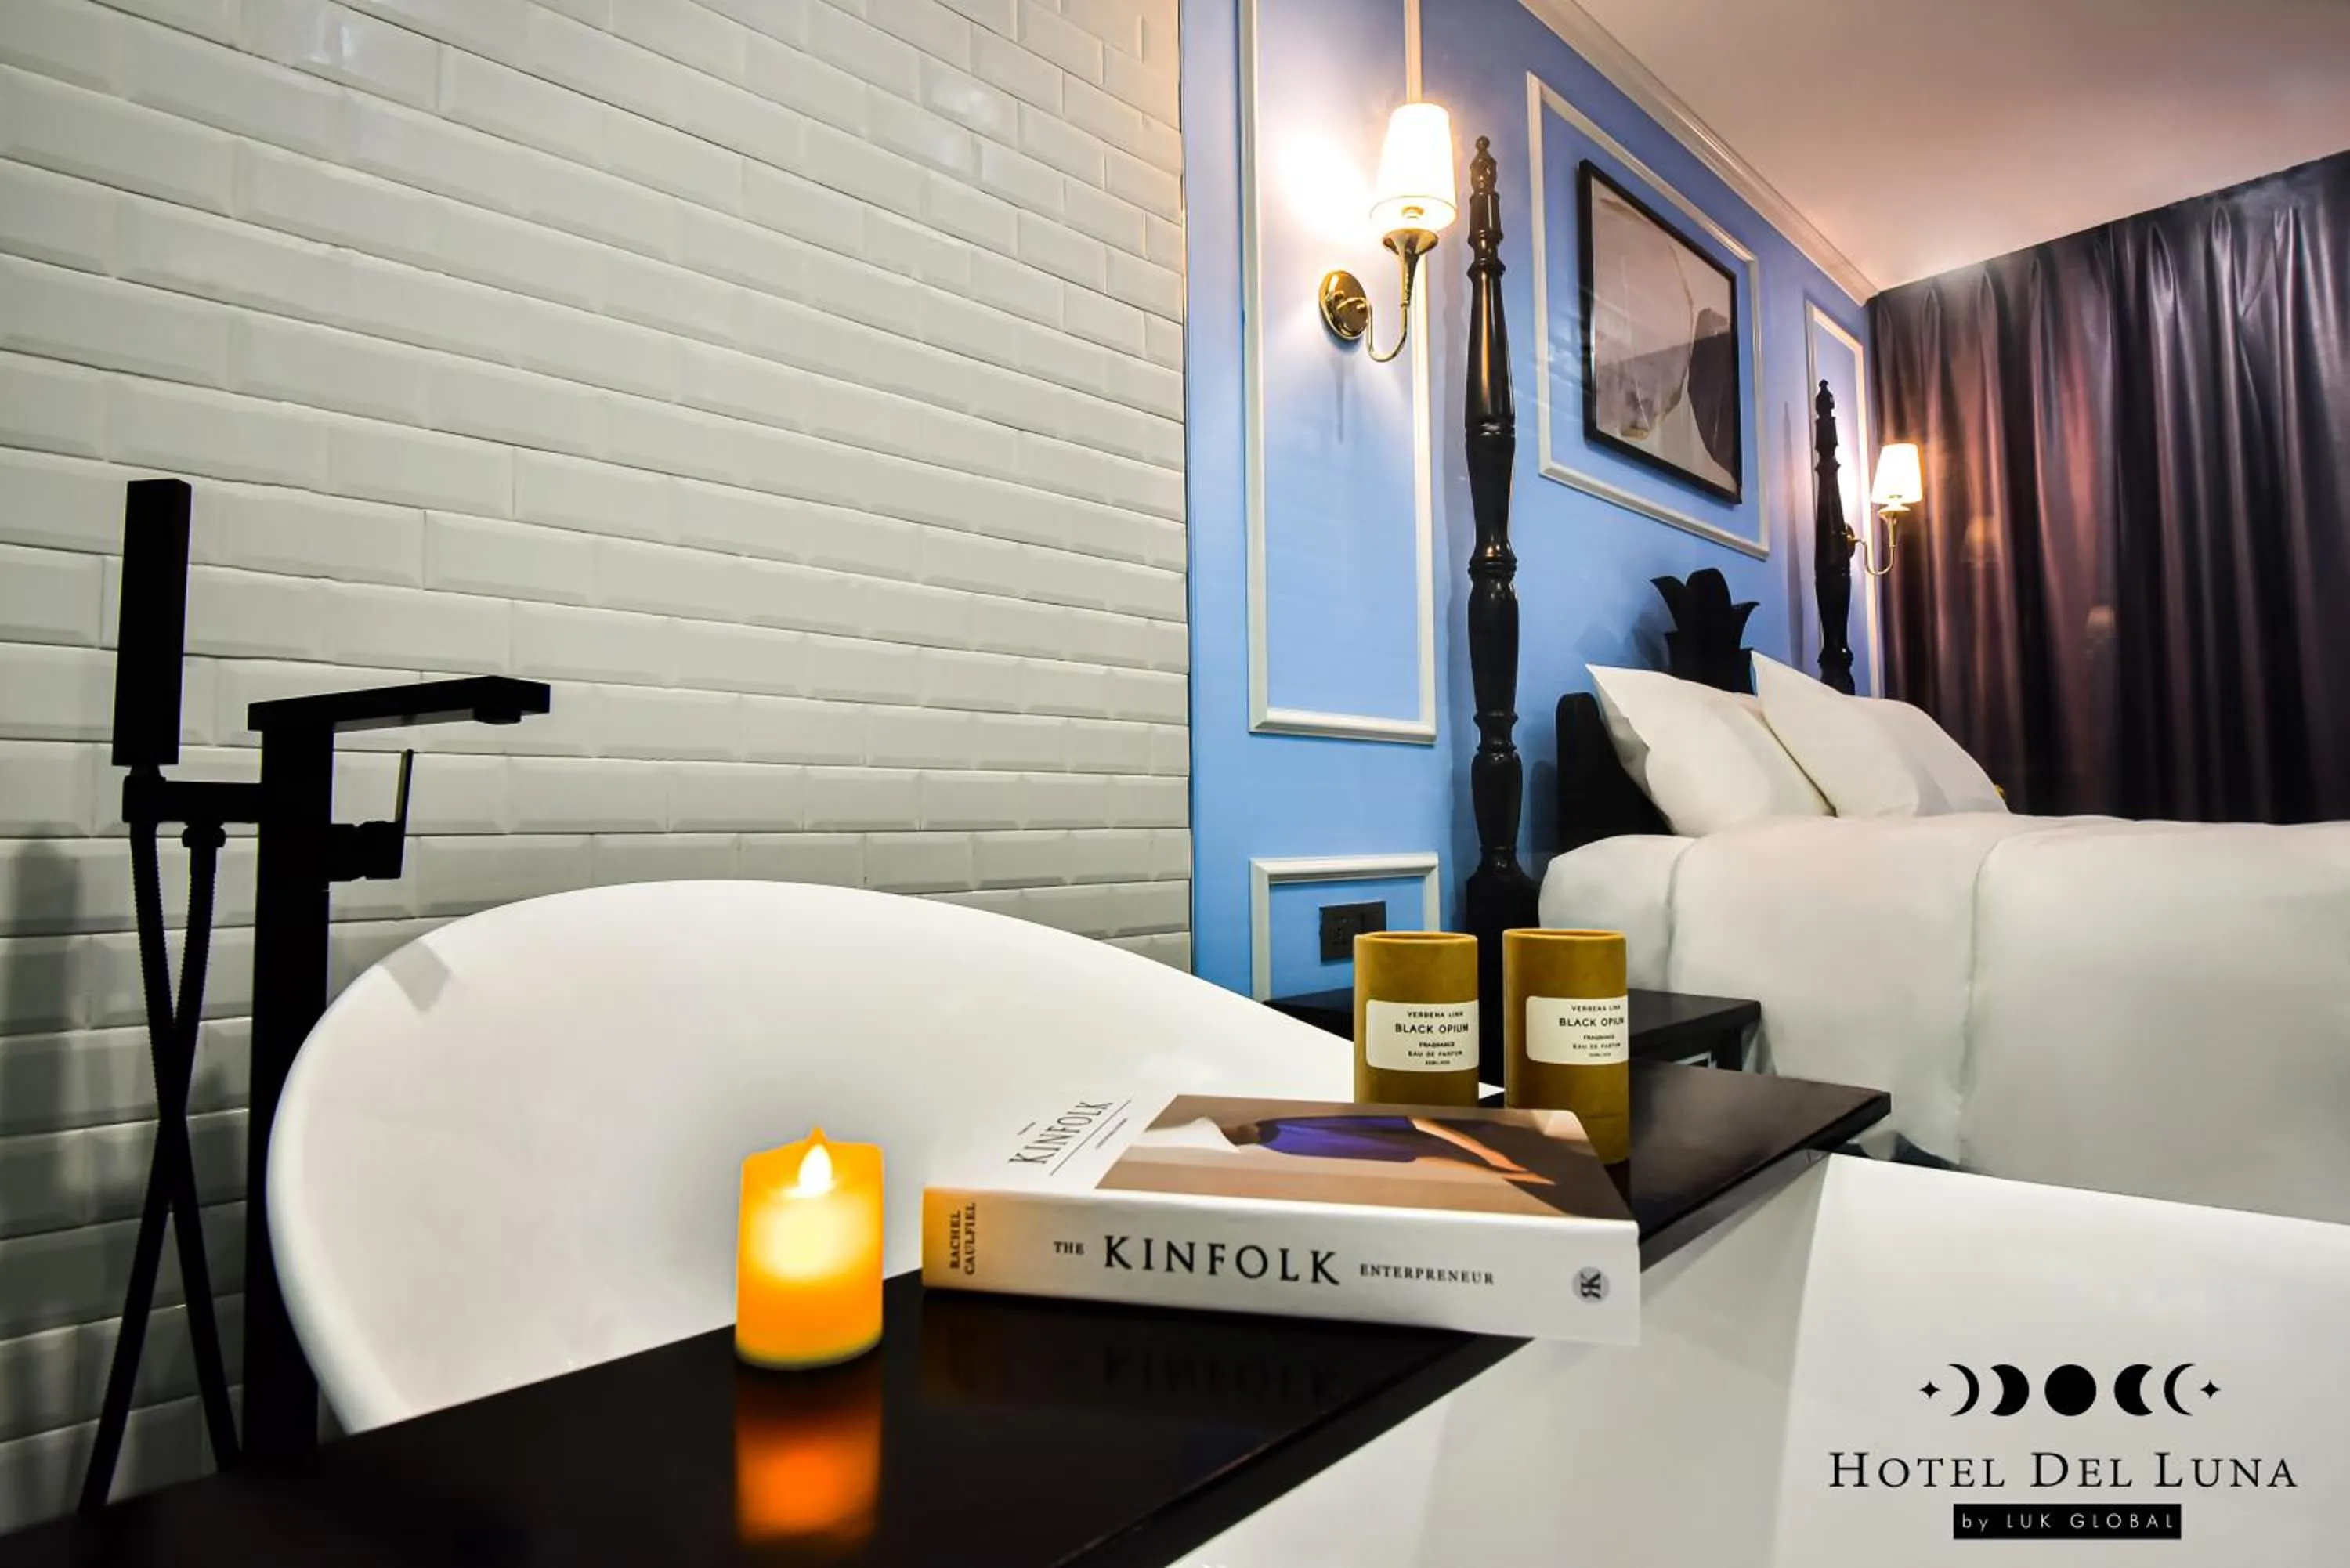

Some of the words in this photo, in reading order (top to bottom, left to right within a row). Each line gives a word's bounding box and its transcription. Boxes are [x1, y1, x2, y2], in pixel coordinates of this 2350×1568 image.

[1395, 1023, 1434, 1034] BLACK
[1438, 1023, 1469, 1034] OPIUM
[1559, 1017, 1596, 1027] BLACK
[1008, 1102, 1113, 1164] KINFOLK
[949, 1209, 960, 1269] RACHEL
[1053, 1241, 1085, 1255] THE
[1104, 1235, 1340, 1286] KINFOLK
